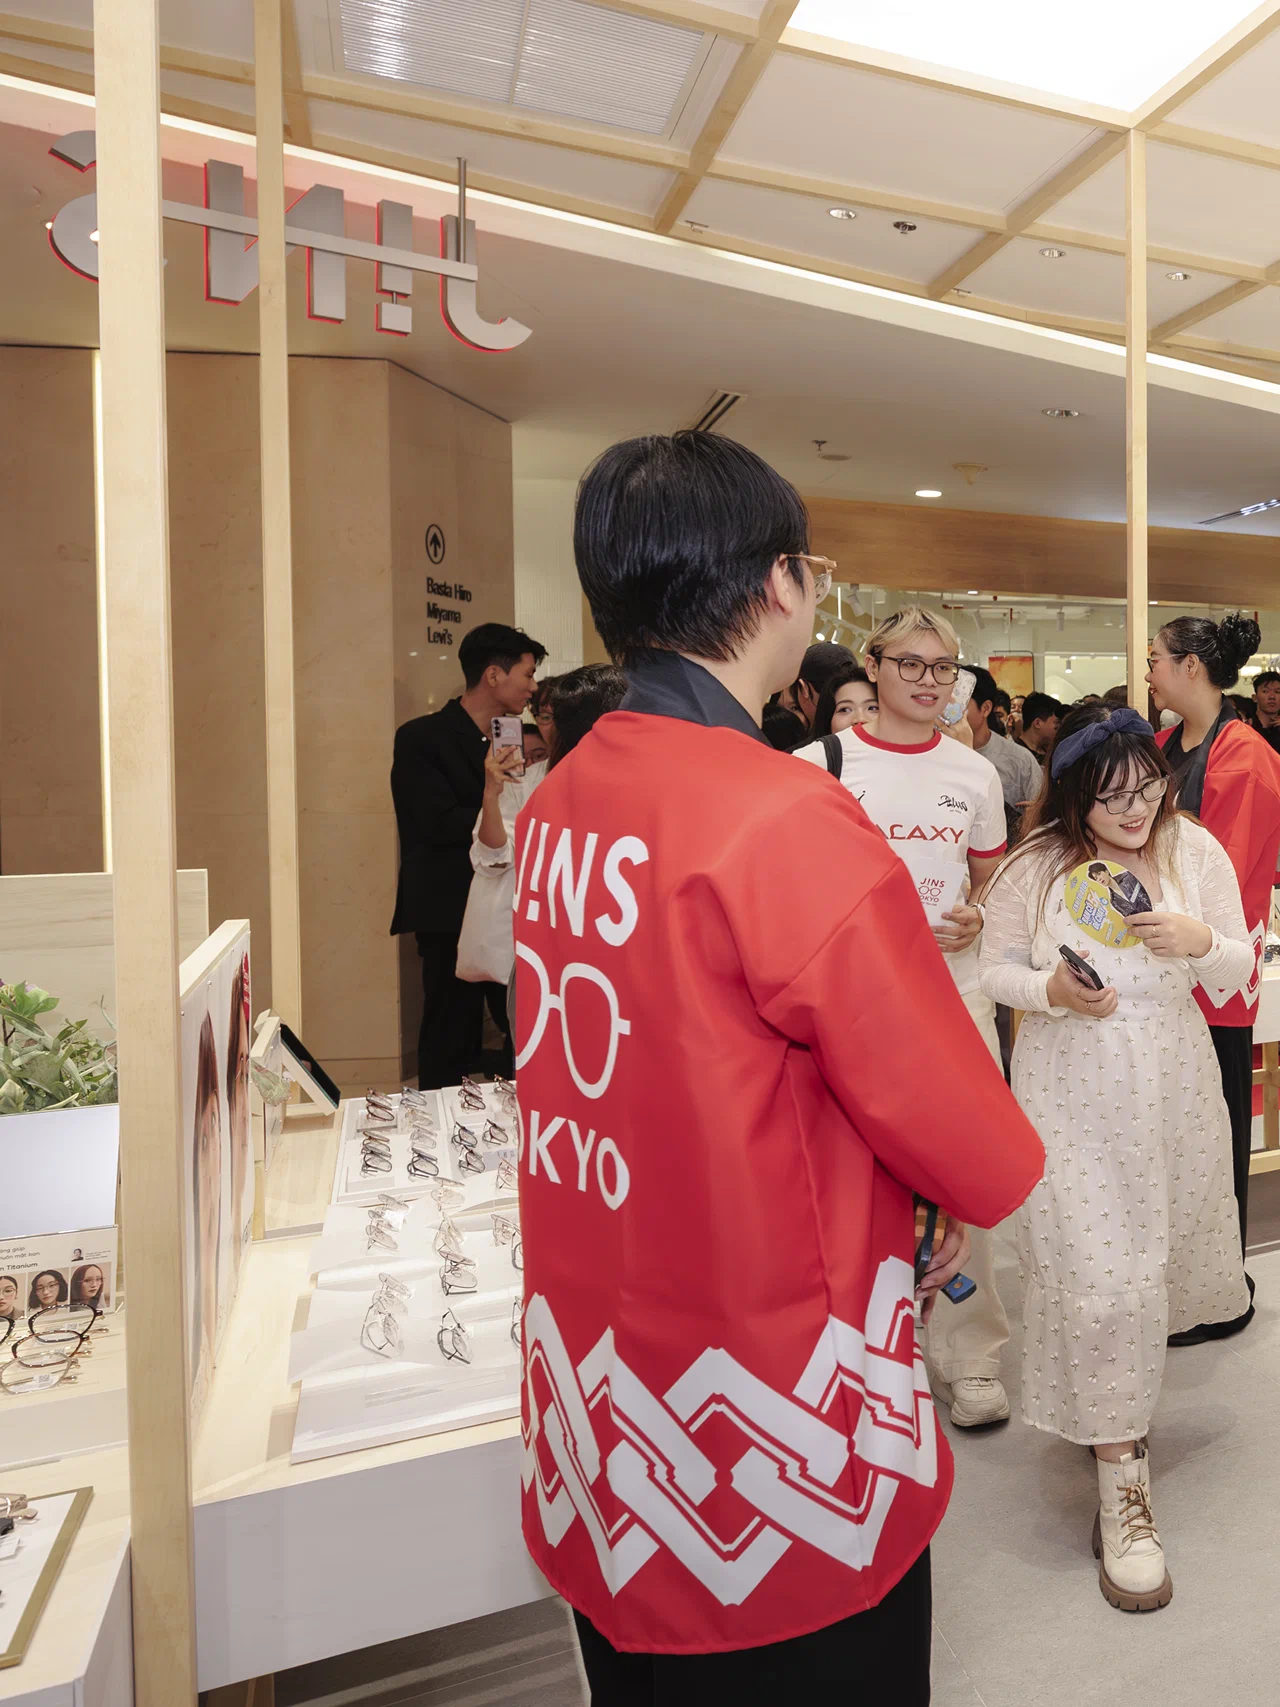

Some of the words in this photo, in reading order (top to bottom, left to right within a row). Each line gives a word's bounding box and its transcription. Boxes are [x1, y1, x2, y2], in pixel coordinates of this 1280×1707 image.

[426, 576, 453, 598] Basta
[454, 583, 472, 603] Hiro
[426, 601, 462, 624] Miyama
[427, 626, 453, 646] Levi's
[919, 895, 940, 904] OKYO
[517, 1109, 631, 1211] KYO
[6, 1262, 39, 1271] Titanium
